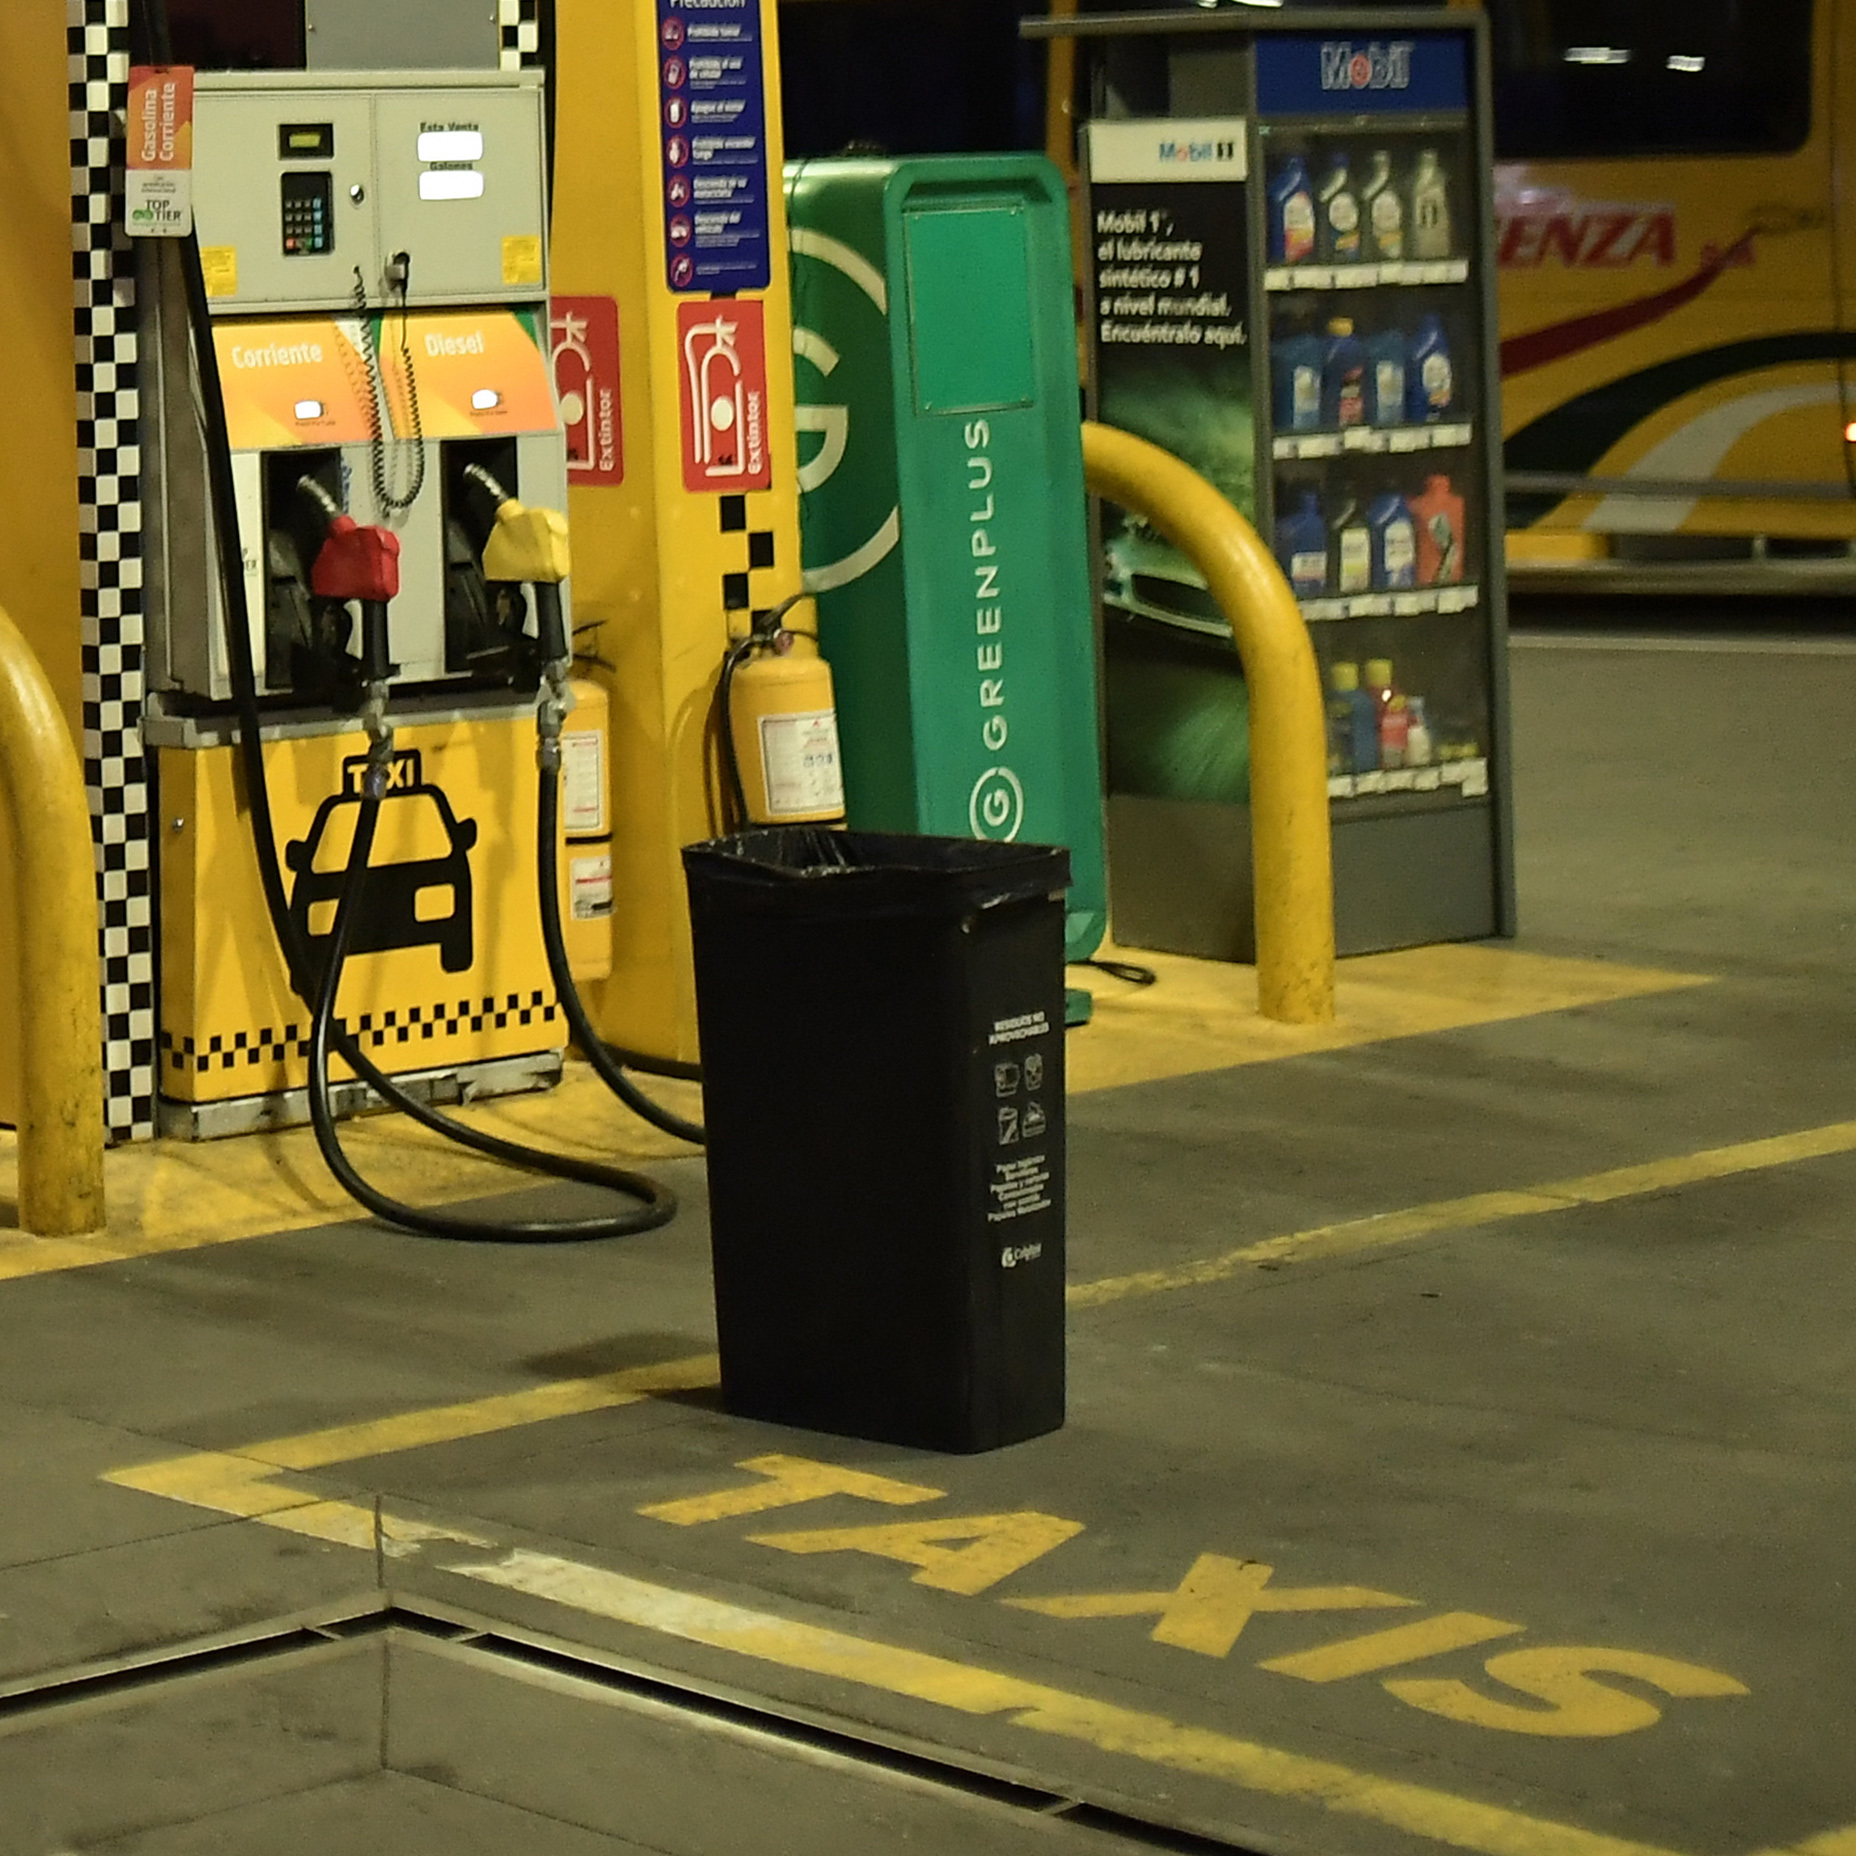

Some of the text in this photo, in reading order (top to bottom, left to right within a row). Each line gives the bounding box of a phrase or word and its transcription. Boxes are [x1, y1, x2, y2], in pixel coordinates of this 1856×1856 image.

[1320, 41, 1412, 90] Mobil
[141, 88, 157, 162] Gasolina
[159, 82, 176, 162] Corriente
[147, 199, 170, 210] TOP
[156, 210, 181, 221] TIER
[1097, 210, 1146, 234] Mobil
[1098, 237, 1203, 261] el lubricante
[1189, 265, 1200, 289] 1
[1114, 292, 1156, 315] nivel
[232, 343, 323, 369] Corriente
[425, 331, 485, 357] Diesel
[599, 389, 614, 472] Extintor
[747, 390, 762, 475] Extintor
[965, 419, 1008, 751] GREENPLUS
[348, 758, 414, 794] TXI
[635, 1453, 1753, 1738] TAXIS
